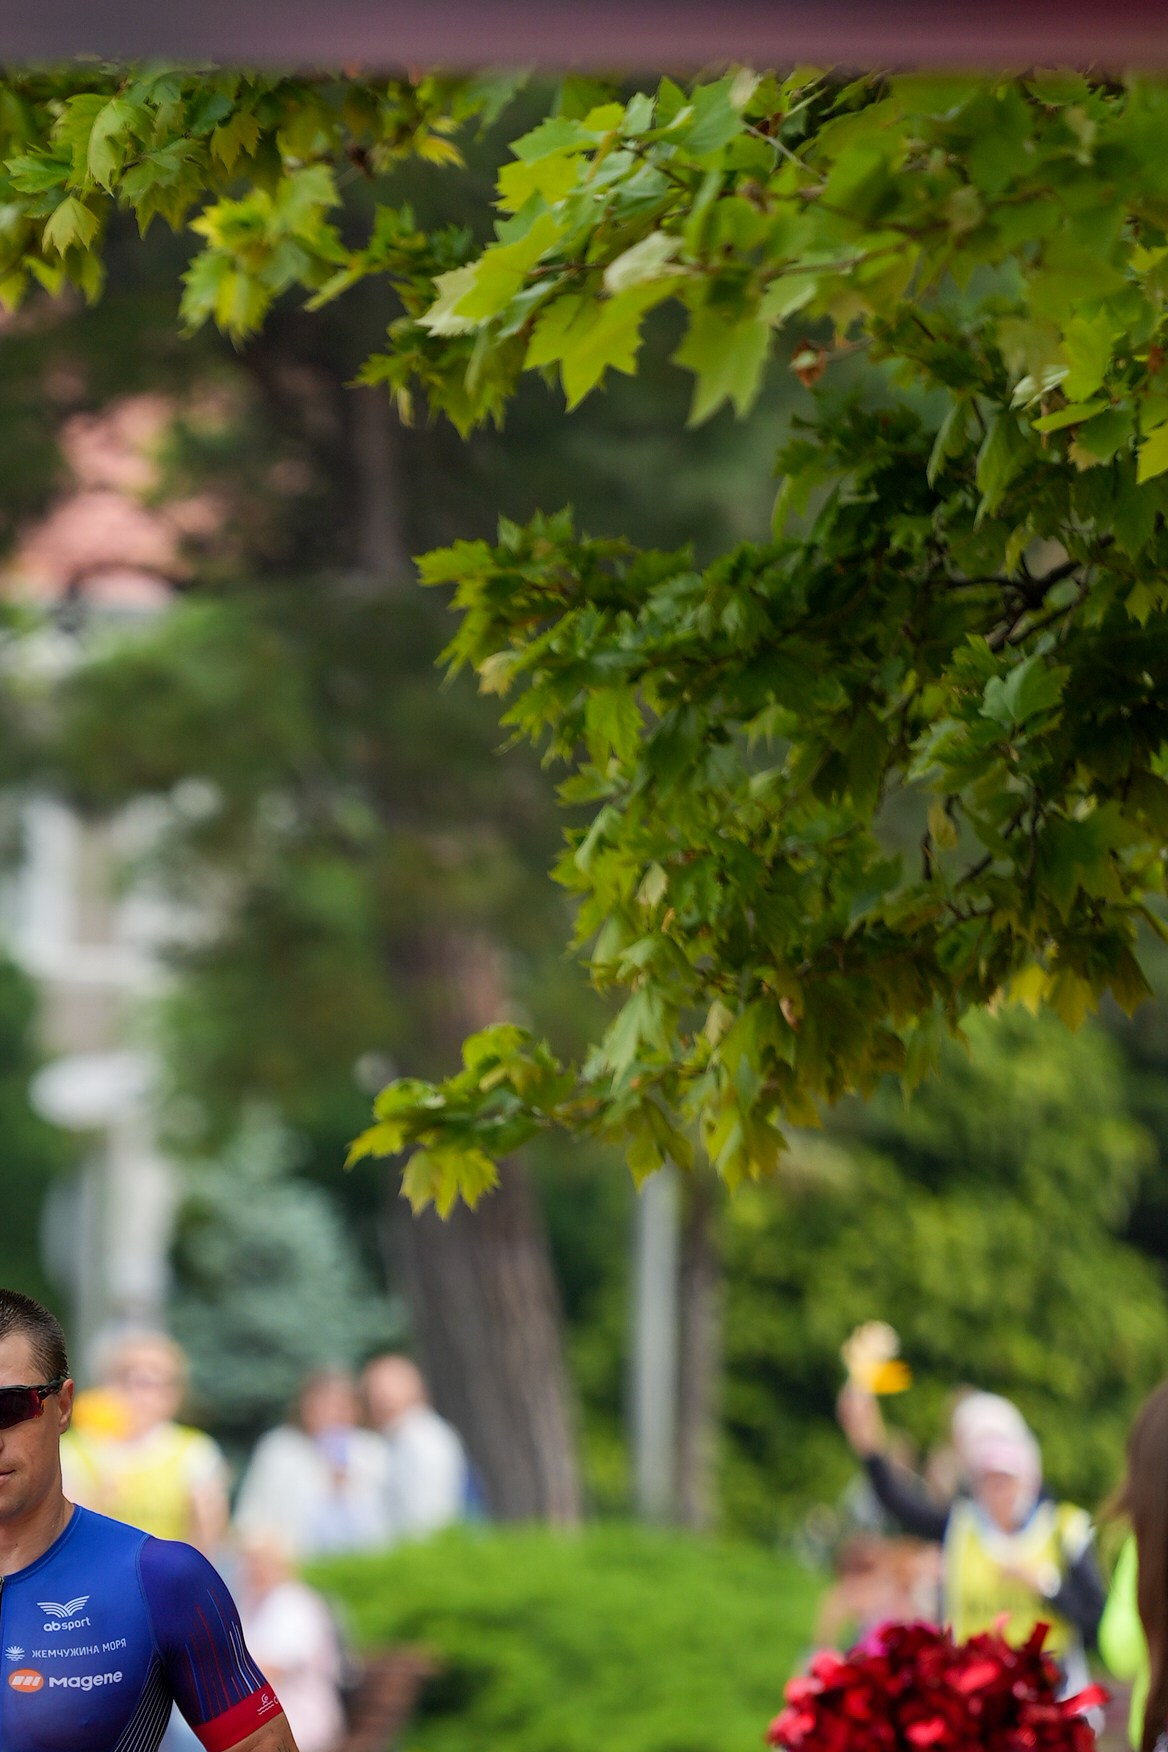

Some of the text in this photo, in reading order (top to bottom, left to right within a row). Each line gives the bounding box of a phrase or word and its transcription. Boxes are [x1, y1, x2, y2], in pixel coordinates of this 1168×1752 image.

[32, 1638, 127, 1659] ЖЕМЧУЖИНА МОРЯ
[48, 1670, 123, 1692] Magene
